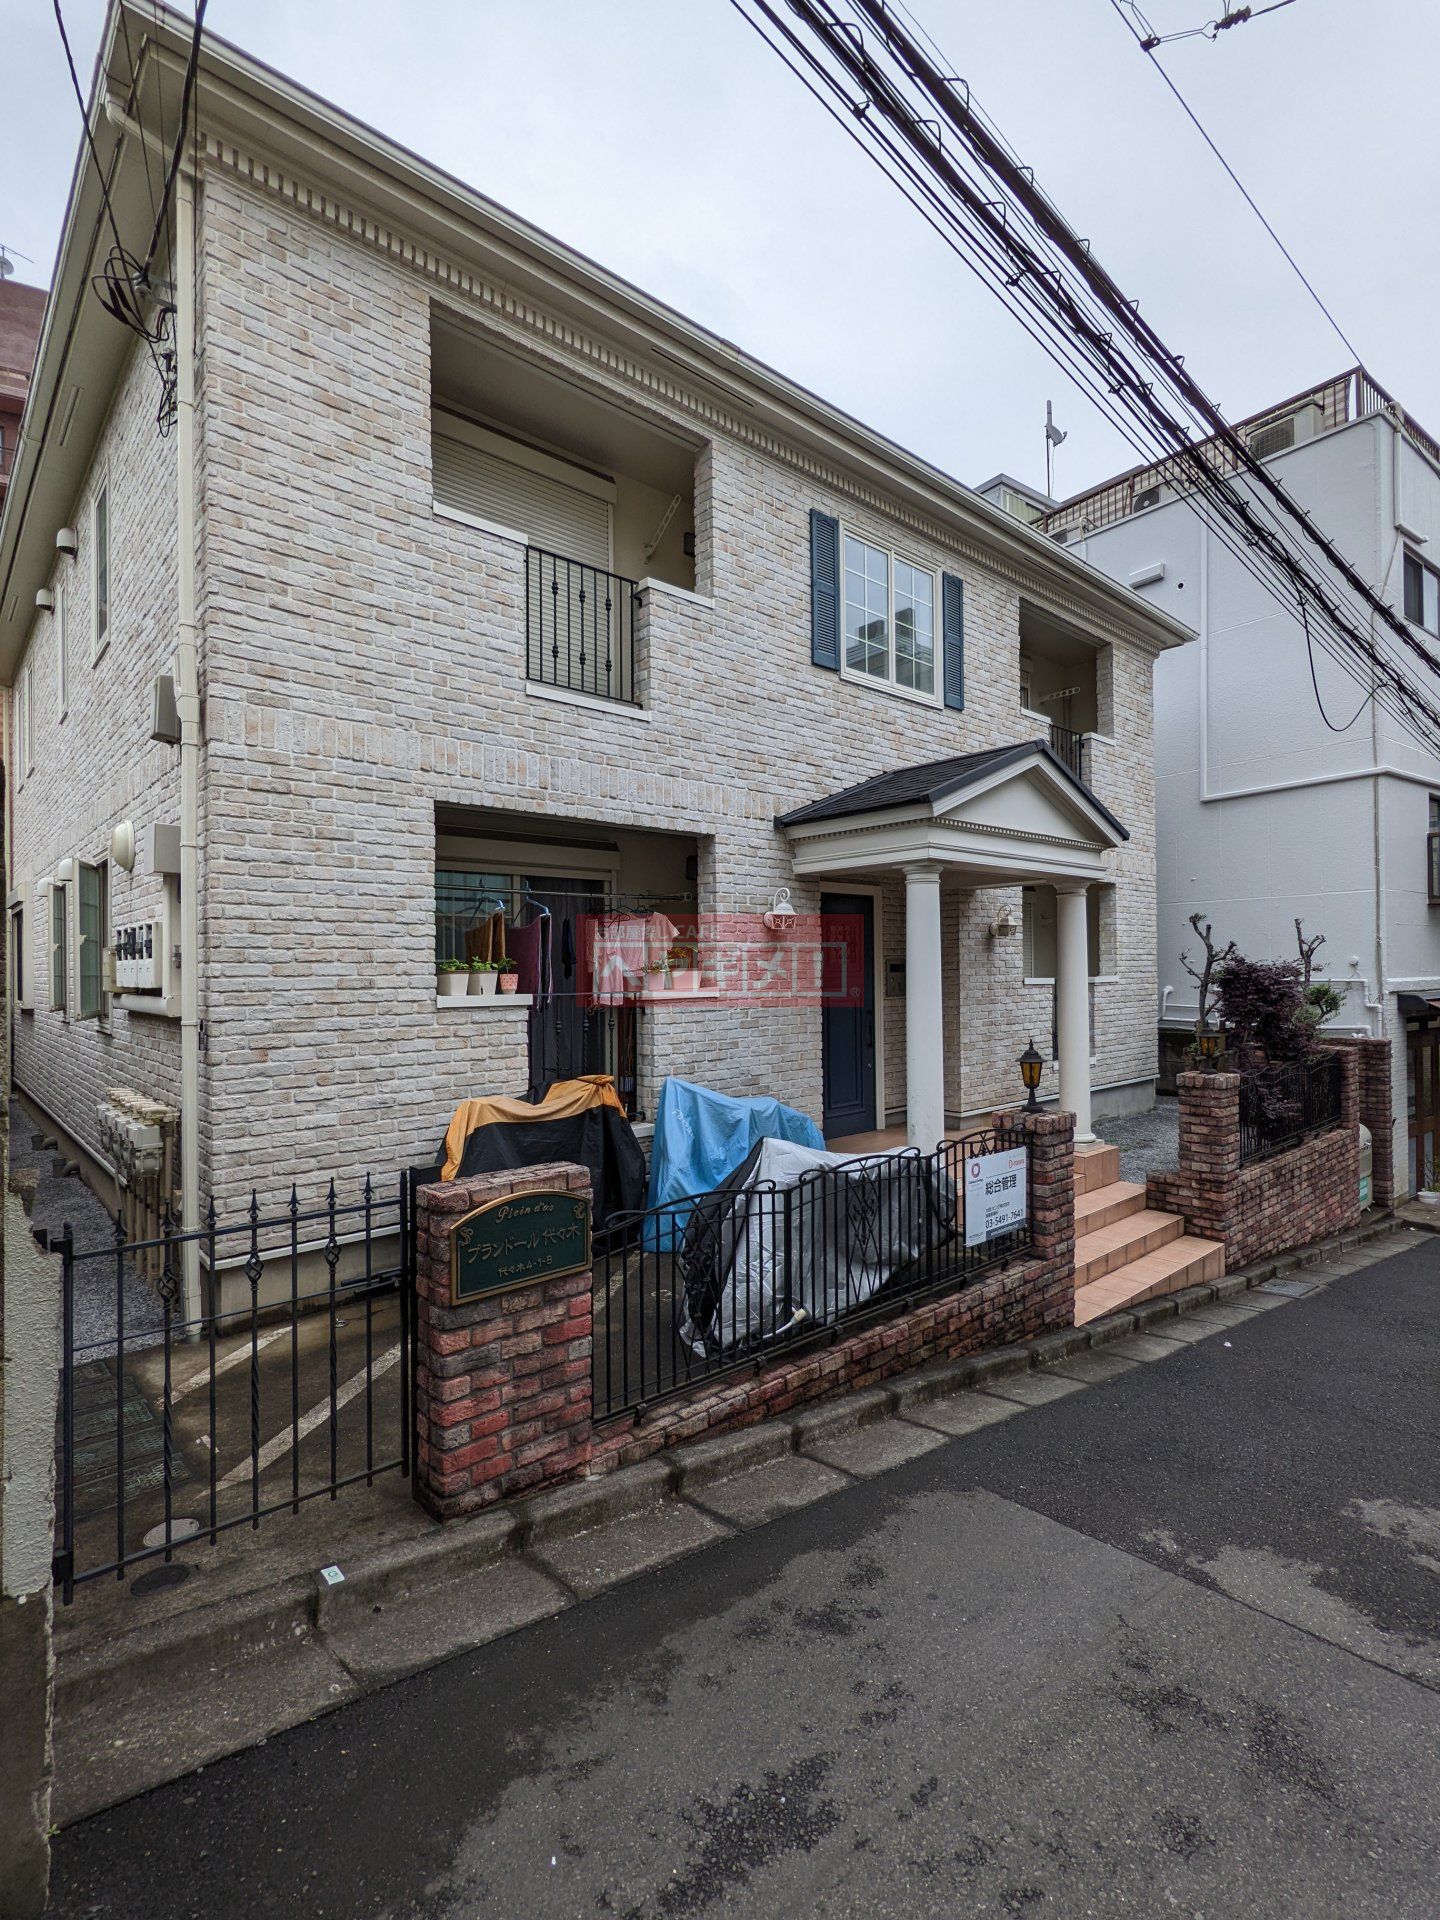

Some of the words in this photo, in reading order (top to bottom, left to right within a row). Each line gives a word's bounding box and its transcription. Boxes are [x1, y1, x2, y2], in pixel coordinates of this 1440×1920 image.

[986, 1174, 1017, 1195] 総合管理
[496, 1206, 531, 1223] Plein
[986, 1209, 1023, 1229] 03-5491-7641
